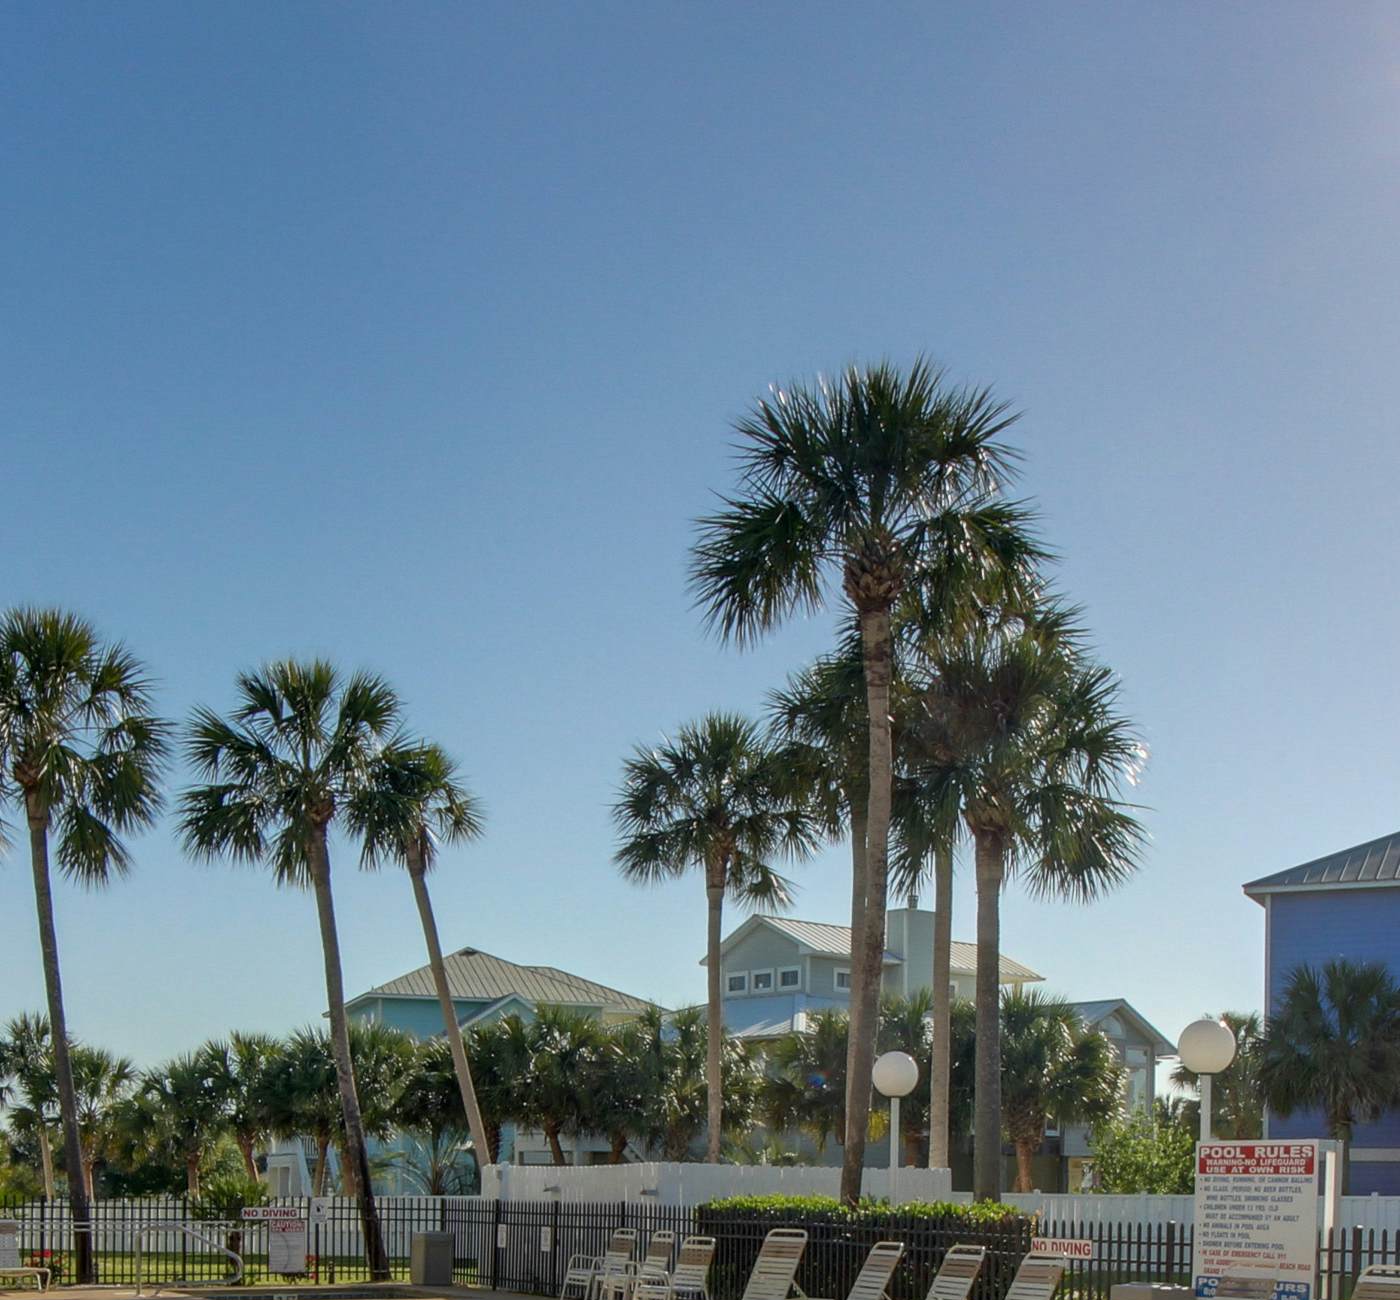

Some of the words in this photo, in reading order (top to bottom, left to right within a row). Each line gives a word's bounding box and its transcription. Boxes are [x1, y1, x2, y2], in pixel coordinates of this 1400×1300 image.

[1200, 1147, 1246, 1158] POOL
[1254, 1146, 1313, 1158] RULES
[243, 1209, 258, 1217] NO
[262, 1209, 297, 1217] DIVING
[1032, 1240, 1047, 1251] NO
[1052, 1242, 1091, 1256] DIVING
